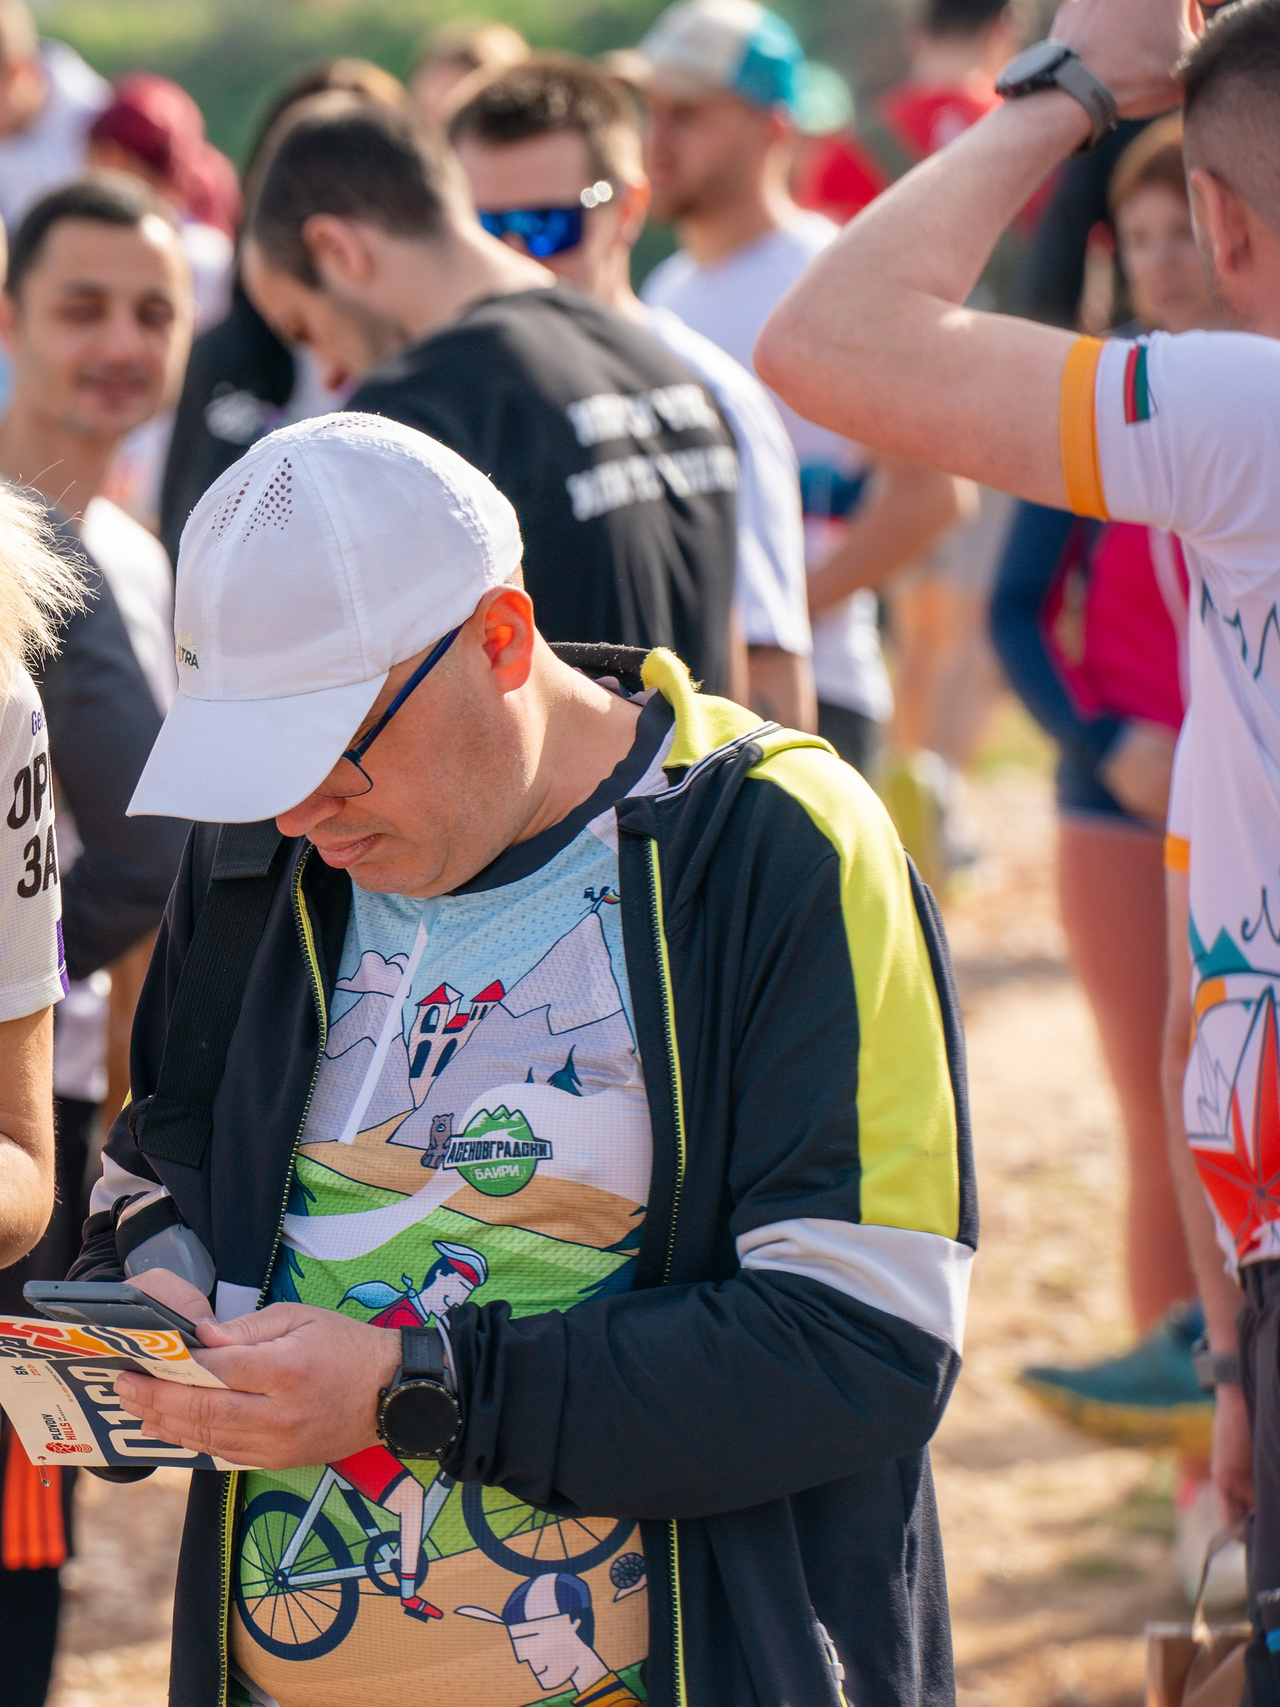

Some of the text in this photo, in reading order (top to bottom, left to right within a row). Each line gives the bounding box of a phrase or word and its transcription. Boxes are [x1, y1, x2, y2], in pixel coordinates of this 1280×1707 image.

[7, 748, 52, 830] ОР
[446, 1140, 548, 1164] АСЕНОВГРАДСКИ
[473, 1164, 520, 1181] БАИРИ
[41, 1413, 64, 1440] PLOVDIV
[59, 1422, 77, 1440] HILLS
